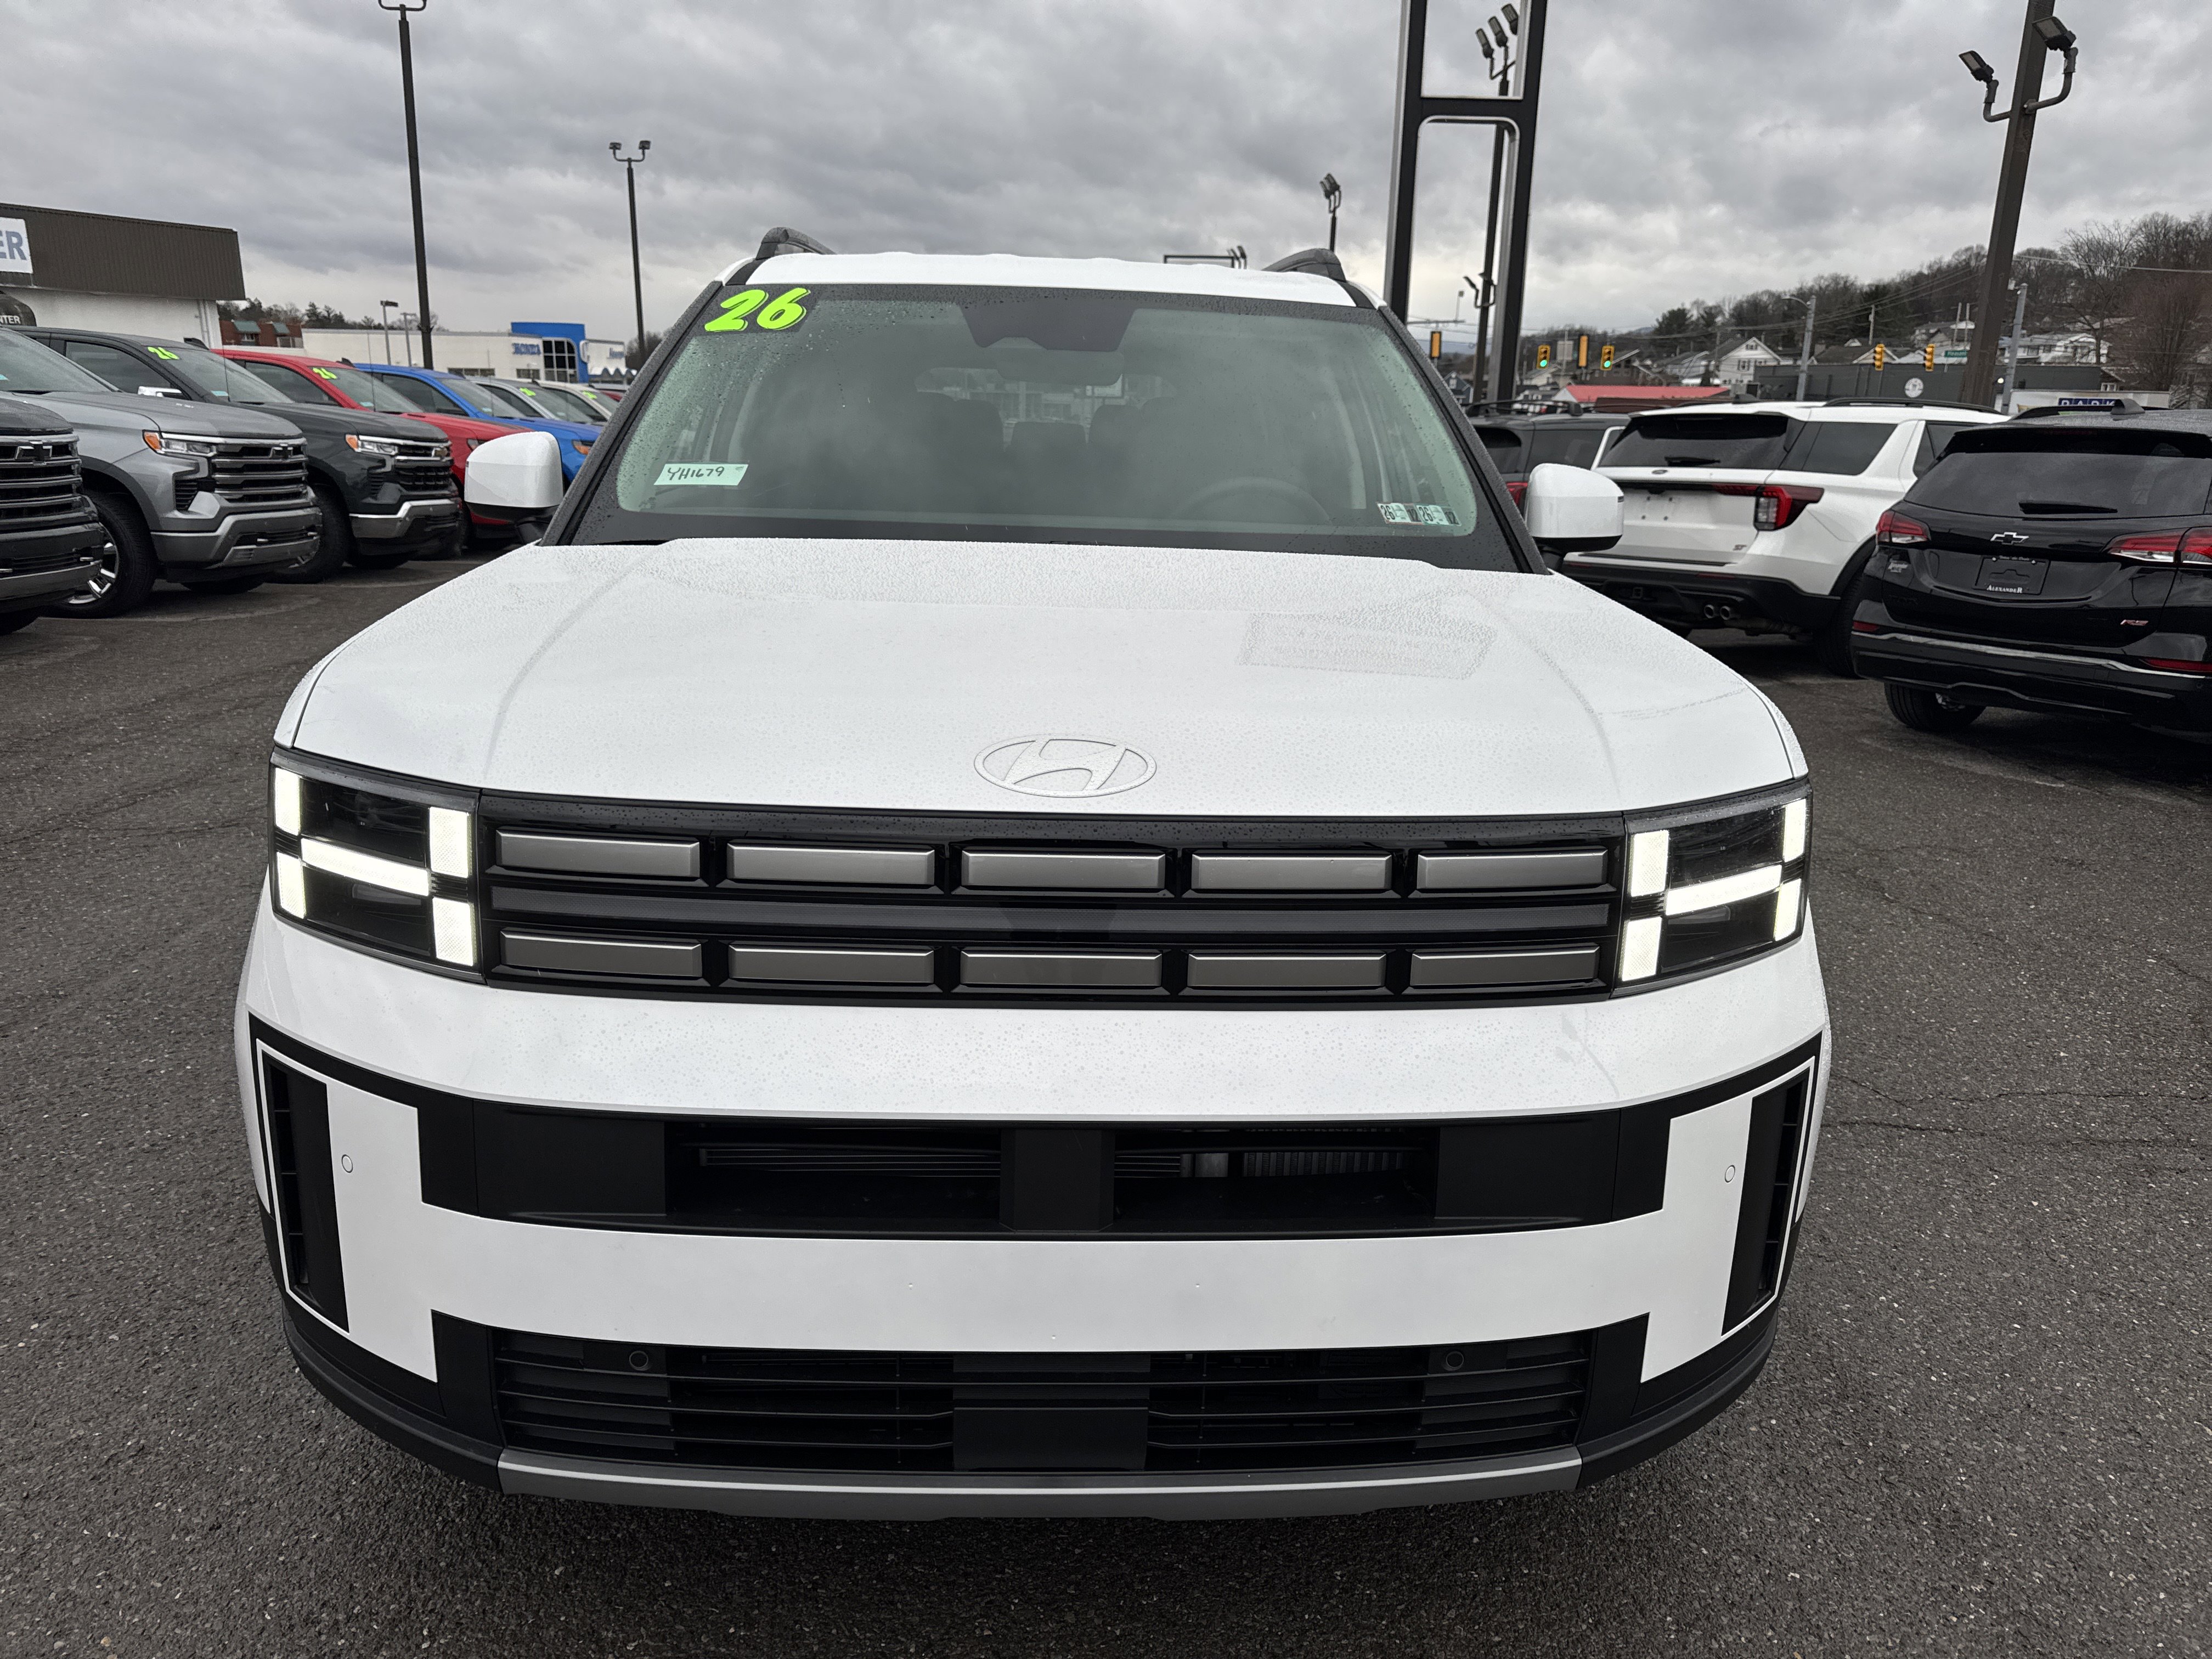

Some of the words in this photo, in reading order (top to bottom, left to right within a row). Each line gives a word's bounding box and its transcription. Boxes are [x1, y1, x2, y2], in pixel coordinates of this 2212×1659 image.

[704, 287, 811, 332] 26
[667, 466, 725, 481] YH1679
[1380, 505, 1396, 520] 26
[1418, 506, 1434, 522] 26
